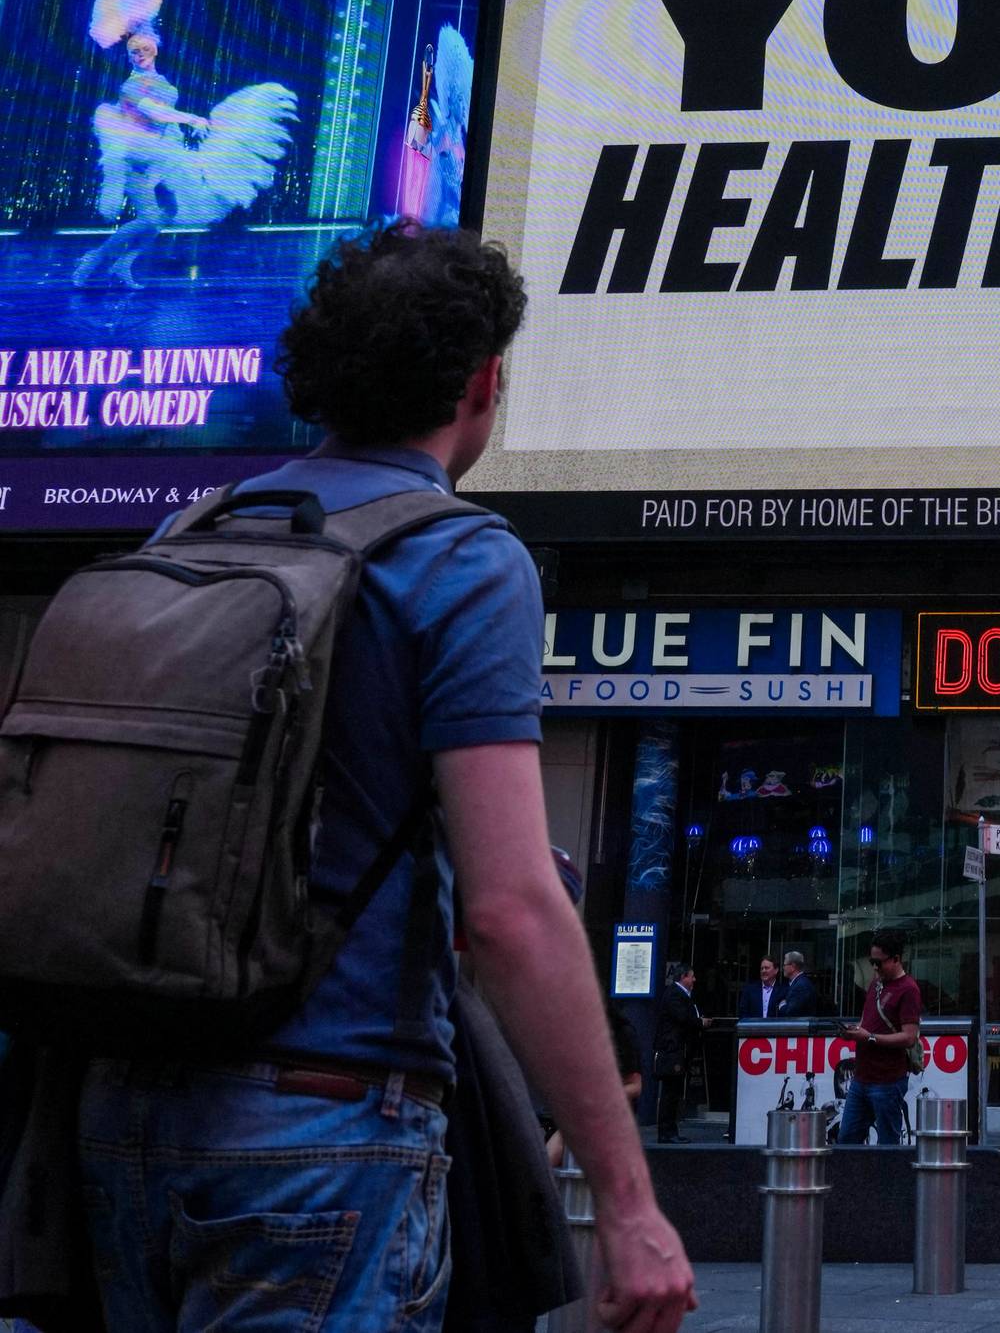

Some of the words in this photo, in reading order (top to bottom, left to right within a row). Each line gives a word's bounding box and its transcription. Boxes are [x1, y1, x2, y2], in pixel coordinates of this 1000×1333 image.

[103, 390, 214, 426] COMEDY
[44, 487, 160, 504] BROADWAY
[165, 487, 180, 503] &
[642, 499, 697, 528] PAID
[705, 499, 753, 527] FOR
[761, 498, 793, 527] BY
[801, 498, 874, 527] HOME
[881, 497, 913, 526] OF
[920, 497, 968, 526] THE
[737, 613, 866, 667] FIN
[739, 680, 865, 702] SUSHI
[640, 925, 654, 933] FIN
[738, 1036, 968, 1075] CHICO
